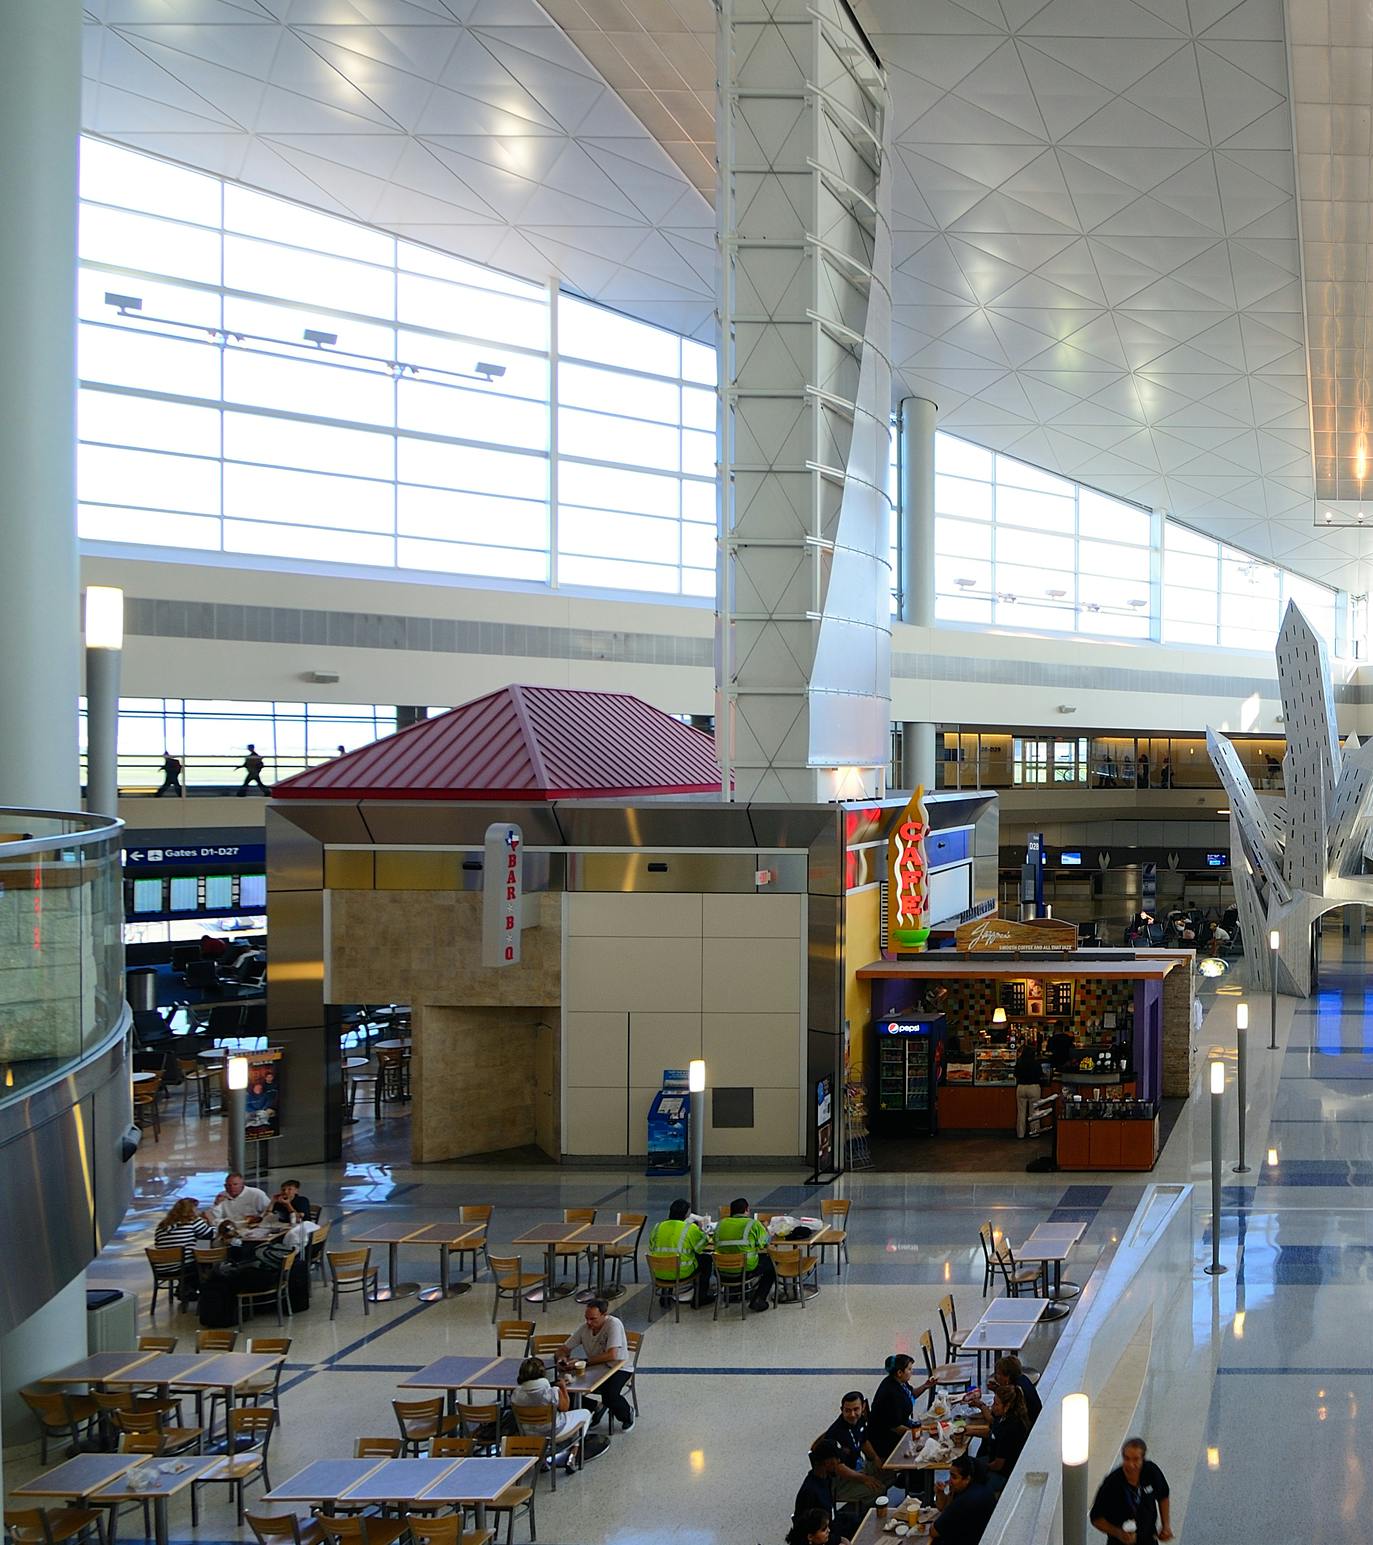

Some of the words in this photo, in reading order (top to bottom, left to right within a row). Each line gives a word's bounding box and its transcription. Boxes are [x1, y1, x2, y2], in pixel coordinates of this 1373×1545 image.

[164, 849, 198, 858] Gates
[200, 847, 240, 856] D1-D27
[900, 822, 923, 915] CAFE
[899, 1024, 920, 1033] pepsi
